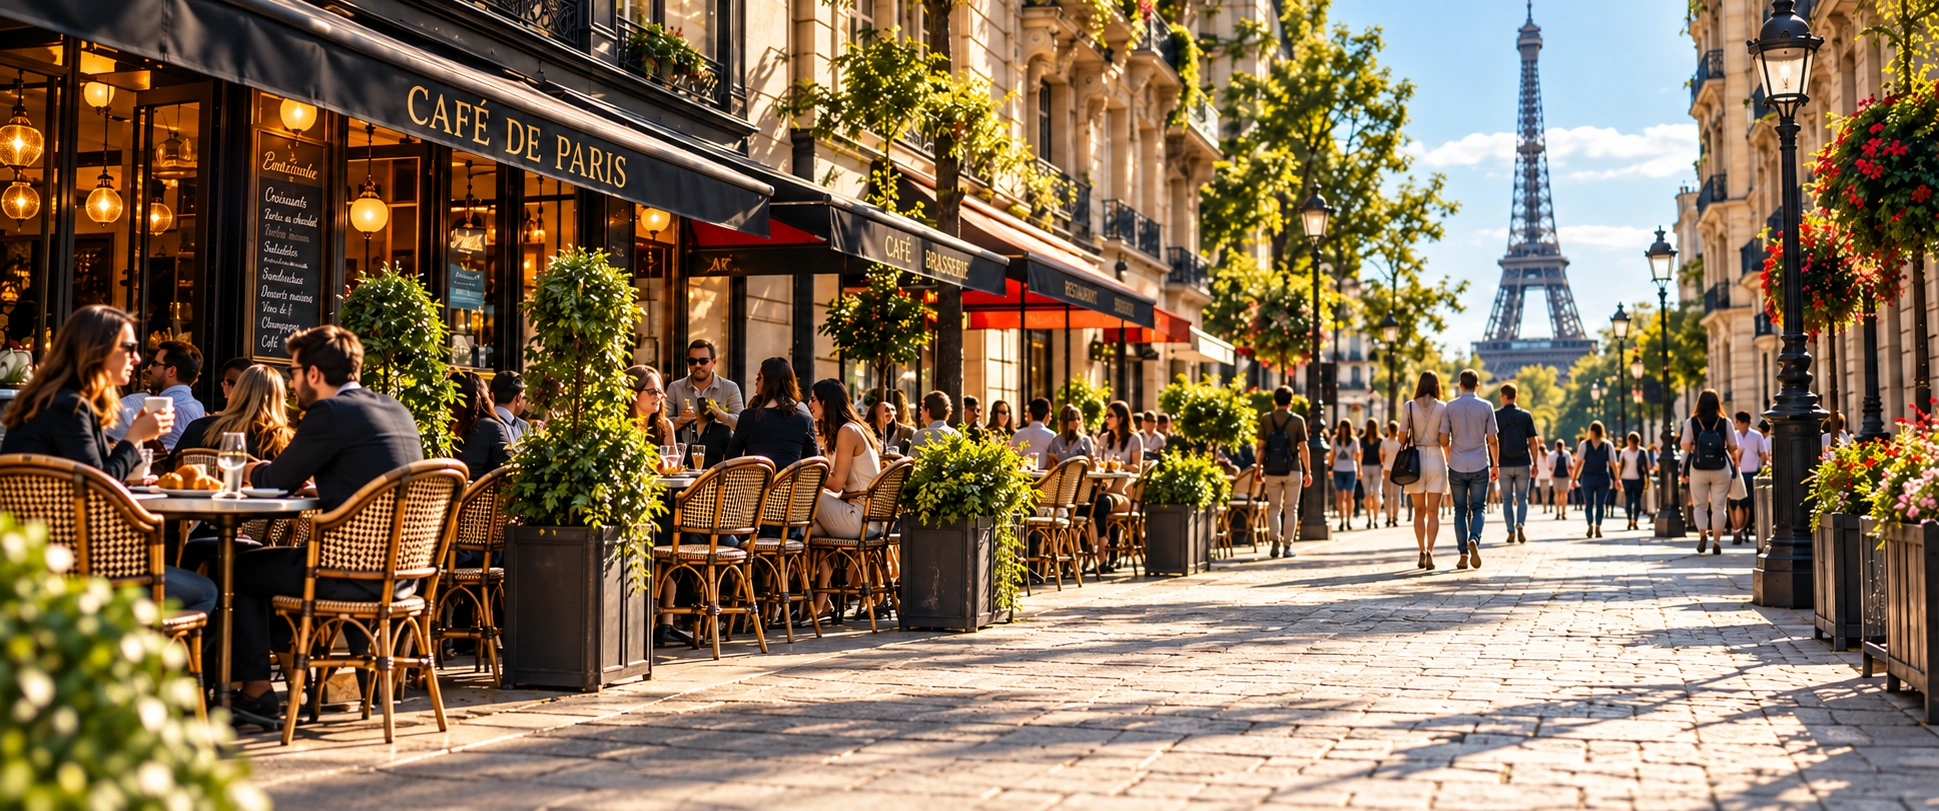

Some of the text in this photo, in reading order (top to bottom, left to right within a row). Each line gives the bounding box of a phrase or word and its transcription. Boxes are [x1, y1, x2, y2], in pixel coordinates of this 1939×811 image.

[407, 85, 627, 189] CAFÉ DE PARIS
[883, 234, 969, 281] CAFÉ BRASSERIE
